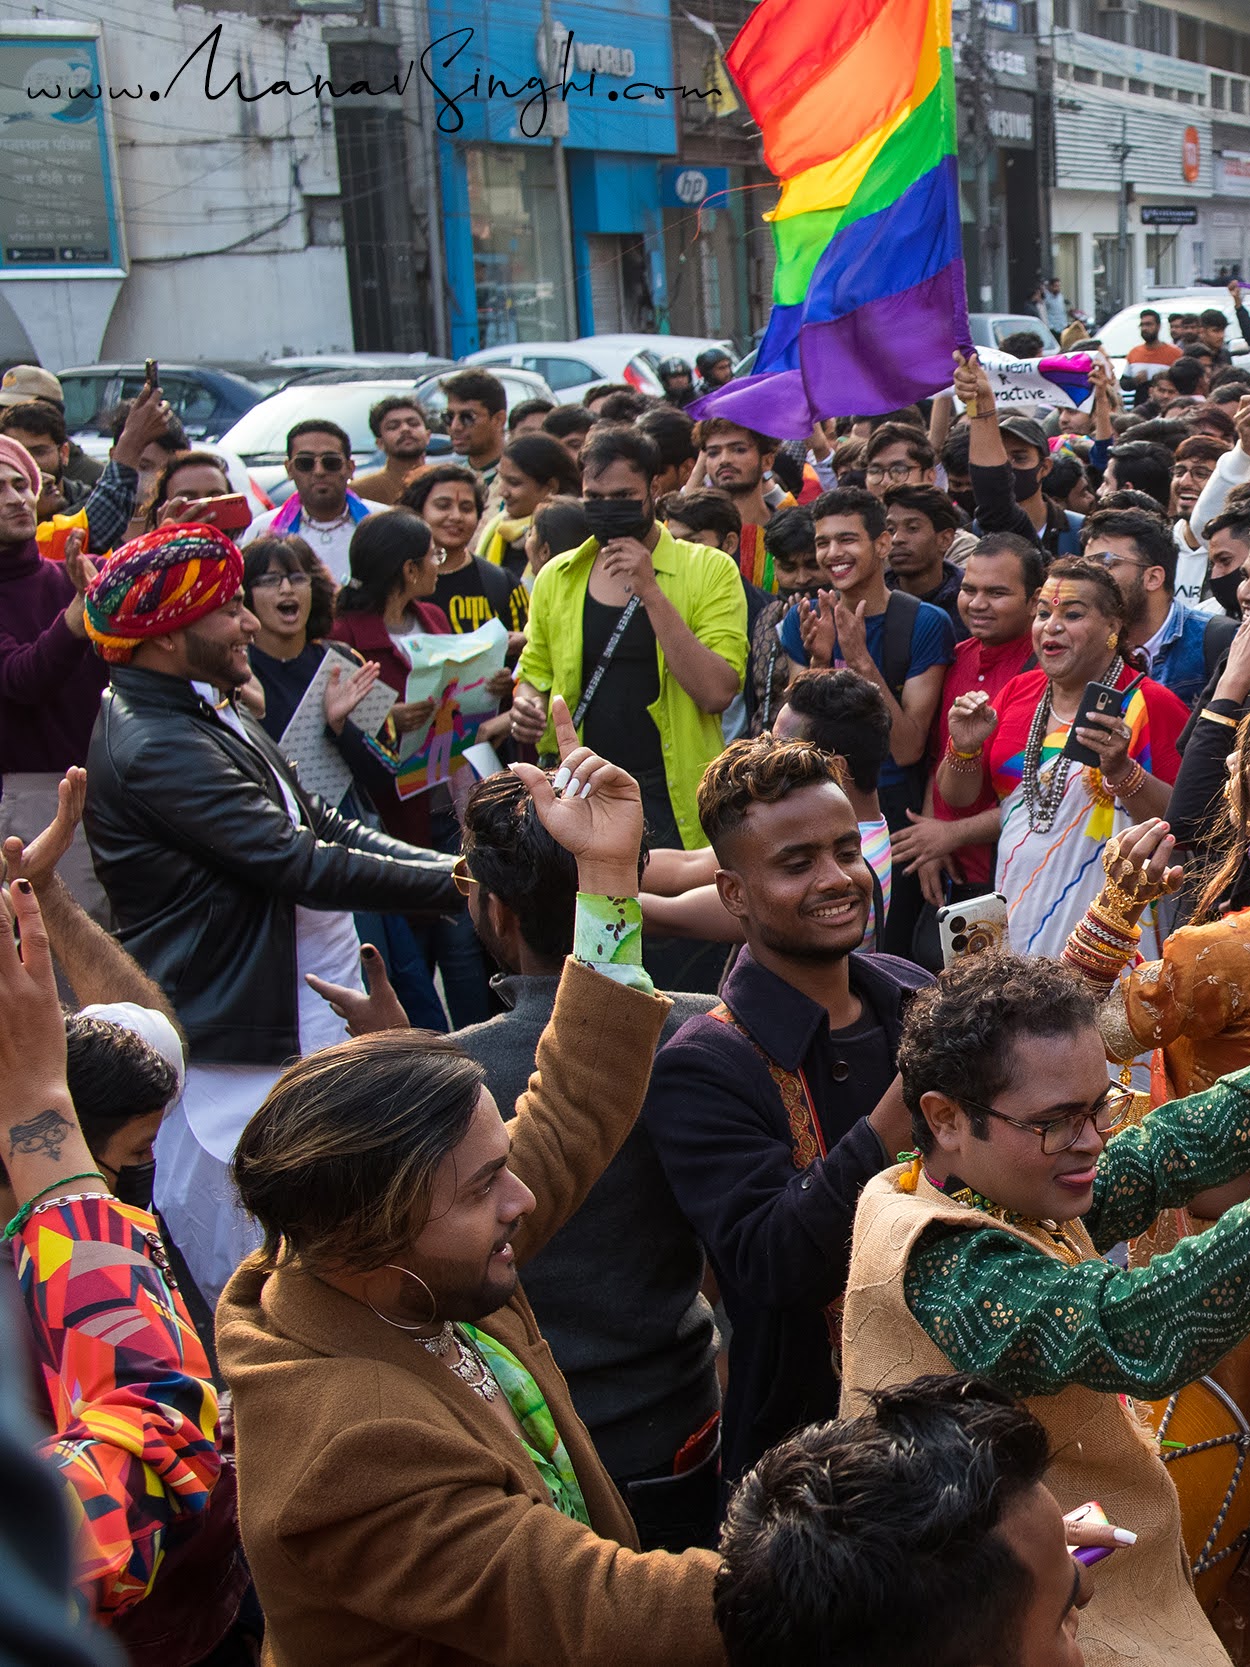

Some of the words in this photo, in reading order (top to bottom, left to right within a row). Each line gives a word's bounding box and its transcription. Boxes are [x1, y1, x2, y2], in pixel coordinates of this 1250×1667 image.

[575, 42, 635, 78] WORLD
[679, 170, 705, 203] hp
[994, 386, 1053, 401] ractive.
[614, 594, 640, 632] FOREVER
